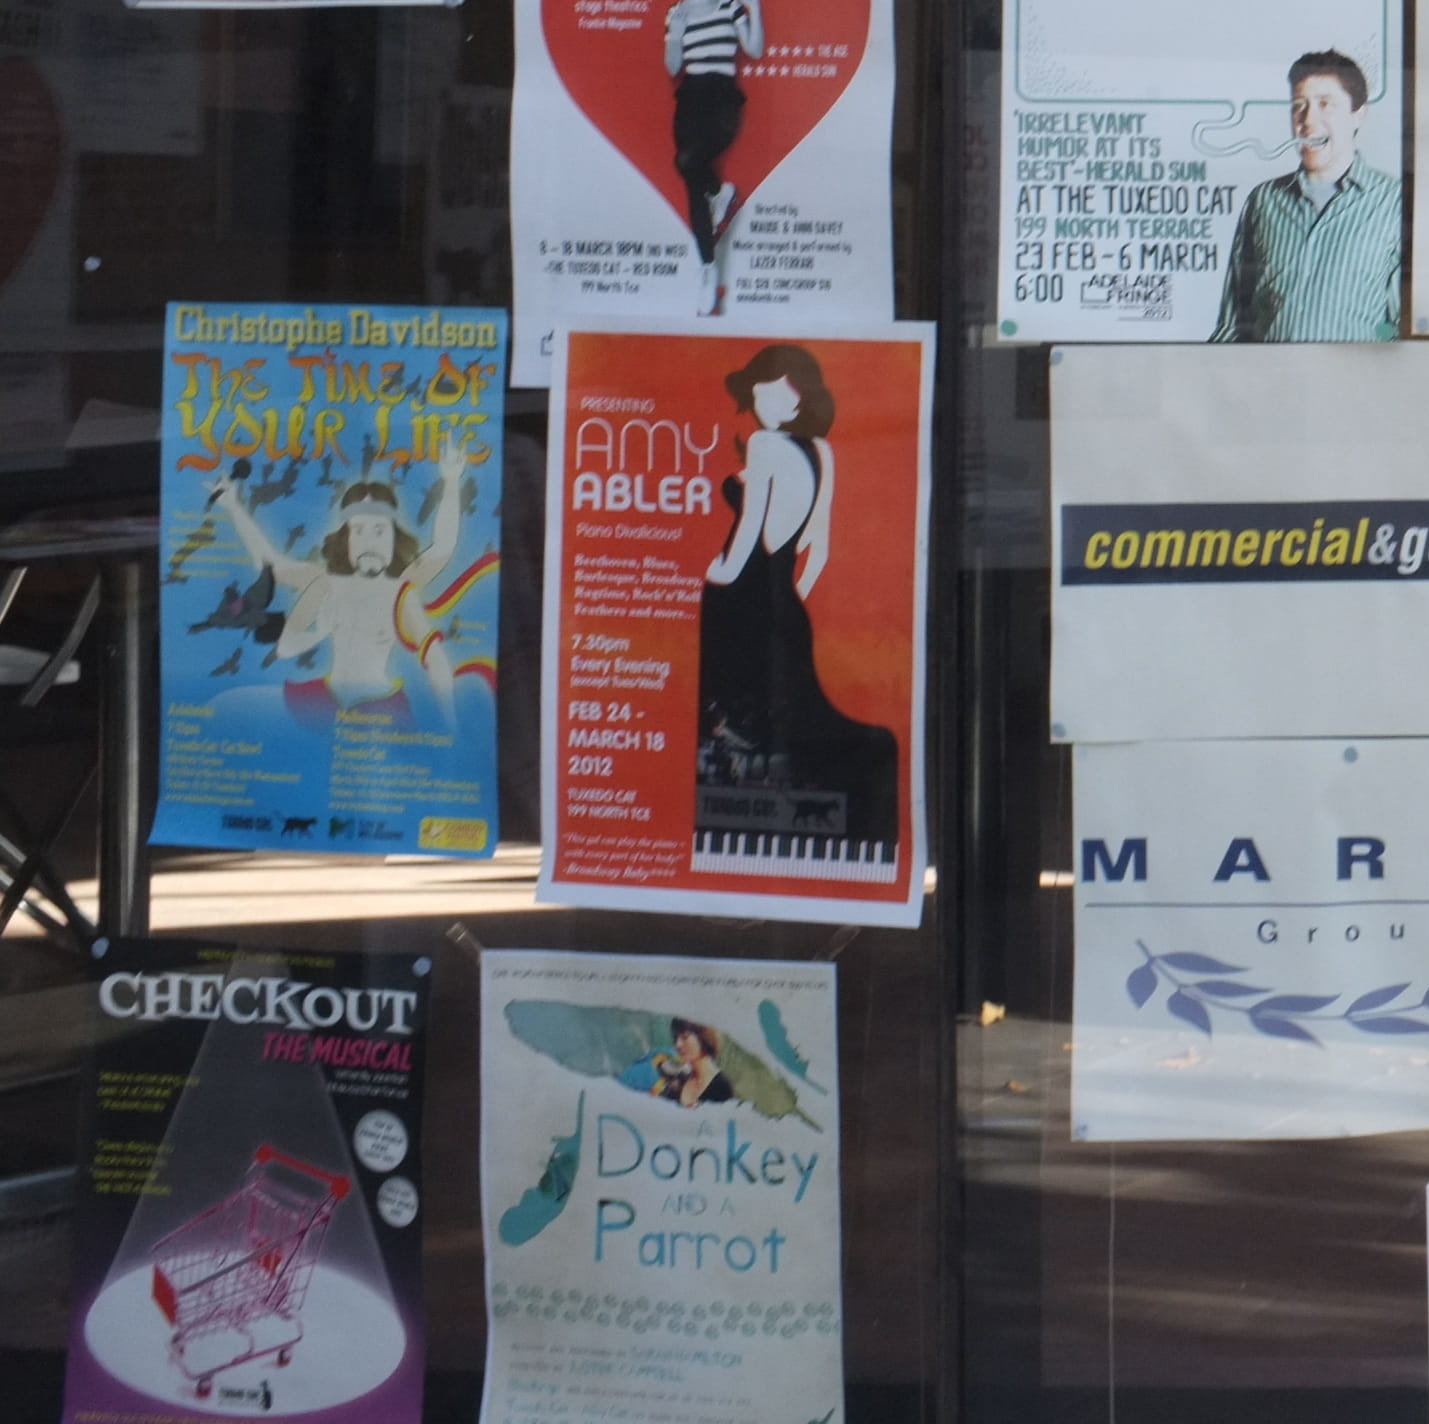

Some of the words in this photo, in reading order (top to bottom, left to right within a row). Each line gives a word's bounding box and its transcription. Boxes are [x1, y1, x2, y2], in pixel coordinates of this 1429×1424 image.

[1017, 136, 1089, 159] HUMOR
[1095, 136, 1121, 158] AT
[1128, 137, 1161, 158] ITS
[1168, 161, 1207, 182] SUN
[1016, 184, 1046, 215] AT
[1051, 184, 1096, 215] THE
[1102, 184, 1189, 215] TUXEDO
[1196, 184, 1238, 216] CAT
[1014, 216, 1048, 240] 199
[1055, 217, 1119, 240] NORTH
[1126, 217, 1213, 240] TERRACE
[1015, 242, 1044, 271] 23
[1051, 242, 1097, 272] FEB
[1119, 243, 1132, 272] 6
[1140, 243, 1219, 273] MARCH
[1015, 274, 1065, 304] 6:00
[175, 306, 344, 352] Christophe
[349, 311, 497, 349] Davidson
[576, 417, 719, 474] AMY
[572, 471, 712, 516] ABLER
[569, 700, 602, 722] FEB
[607, 702, 633, 723] 24
[568, 728, 640, 751] MARCH
[646, 731, 666, 753] 18
[568, 755, 614, 777] 2012
[100, 970, 418, 1036] CHECKOUT
[262, 1031, 309, 1064] THE
[310, 1035, 413, 1074] MUSICAL
[596, 1113, 820, 1203] Donkey
[594, 1198, 787, 1275] Parrot
